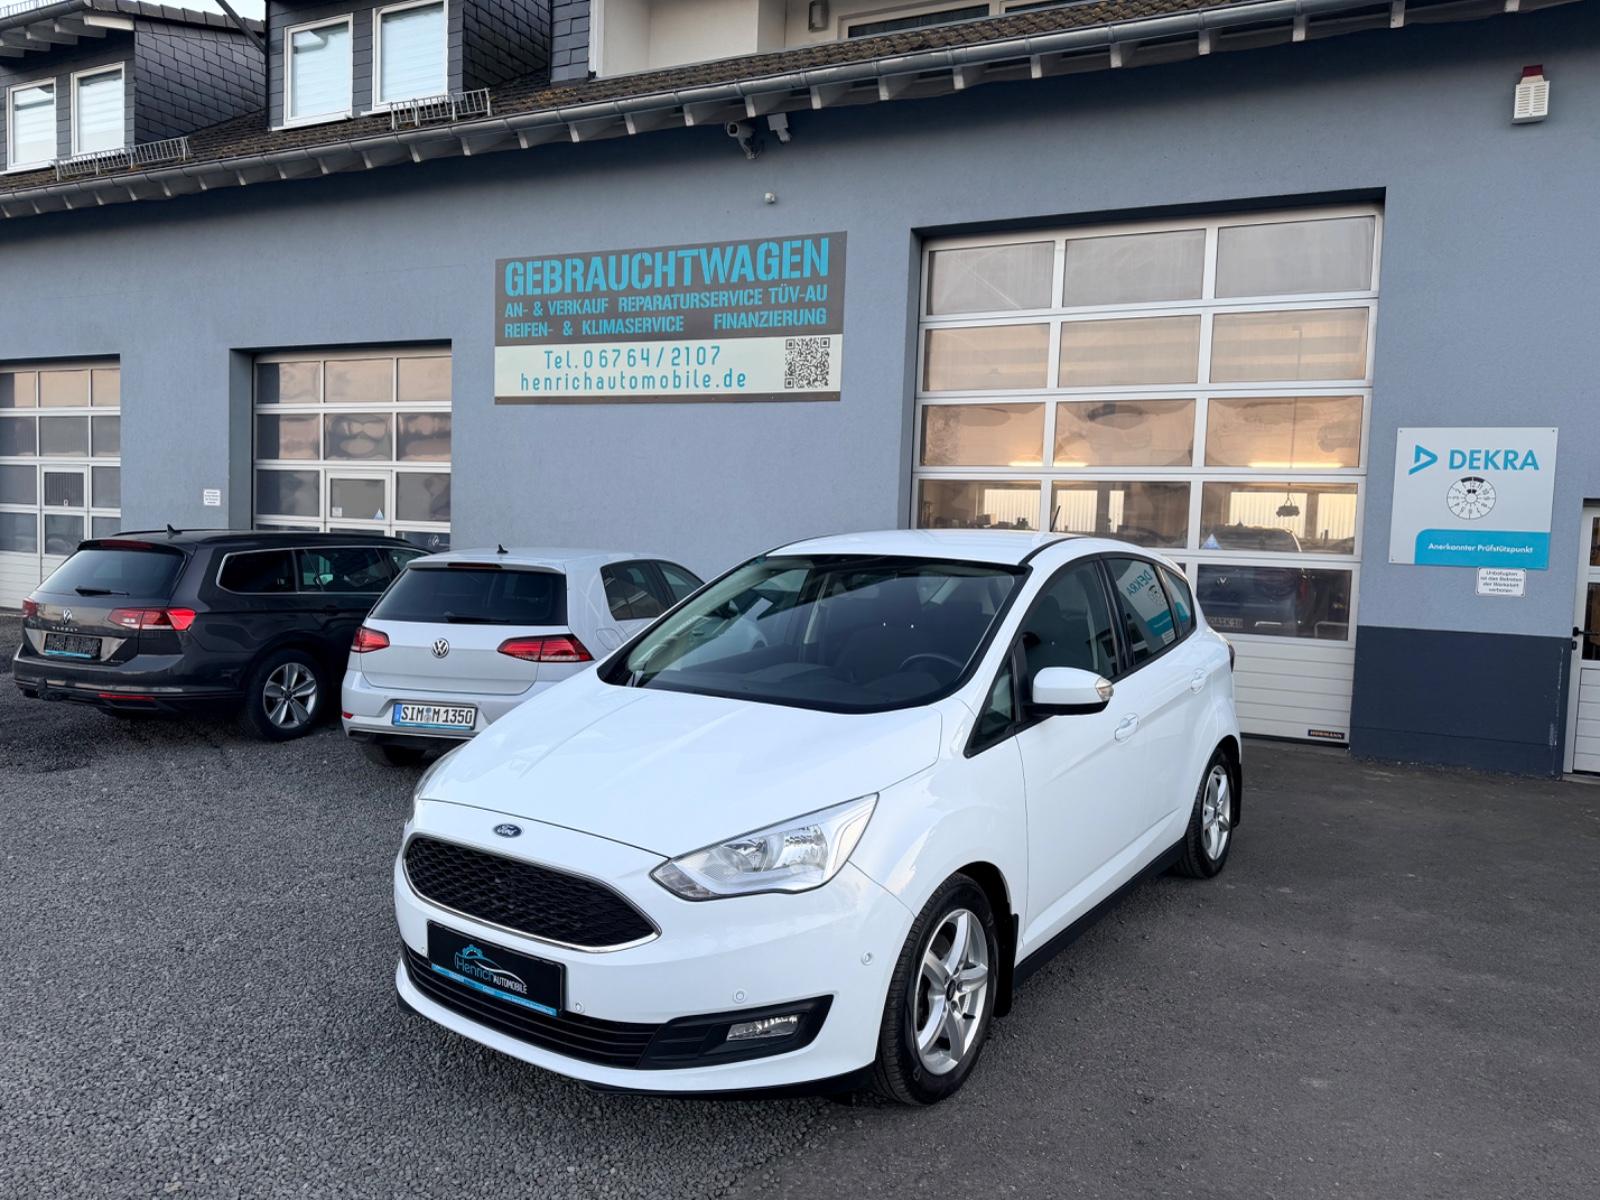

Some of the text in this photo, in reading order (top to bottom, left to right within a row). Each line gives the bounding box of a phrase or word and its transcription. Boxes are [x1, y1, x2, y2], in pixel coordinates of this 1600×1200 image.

[504, 238, 829, 297] GEBRAUCHTWAGEN
[505, 283, 828, 318] AN- & VERKAUF REPARATURSERVICE TÜV-AU
[505, 307, 827, 338] REIFEN- & KLIMASERVICE FINANZIERUNG
[520, 368, 747, 391] henrichautomobile.de
[1448, 448, 1540, 471] DEKRA
[1428, 542, 1534, 554] Anerkannter Prüfstützpunkt
[401, 706, 425, 722] SIM
[442, 708, 474, 725] 1350
[493, 975, 528, 995] AUTOMOBILE
